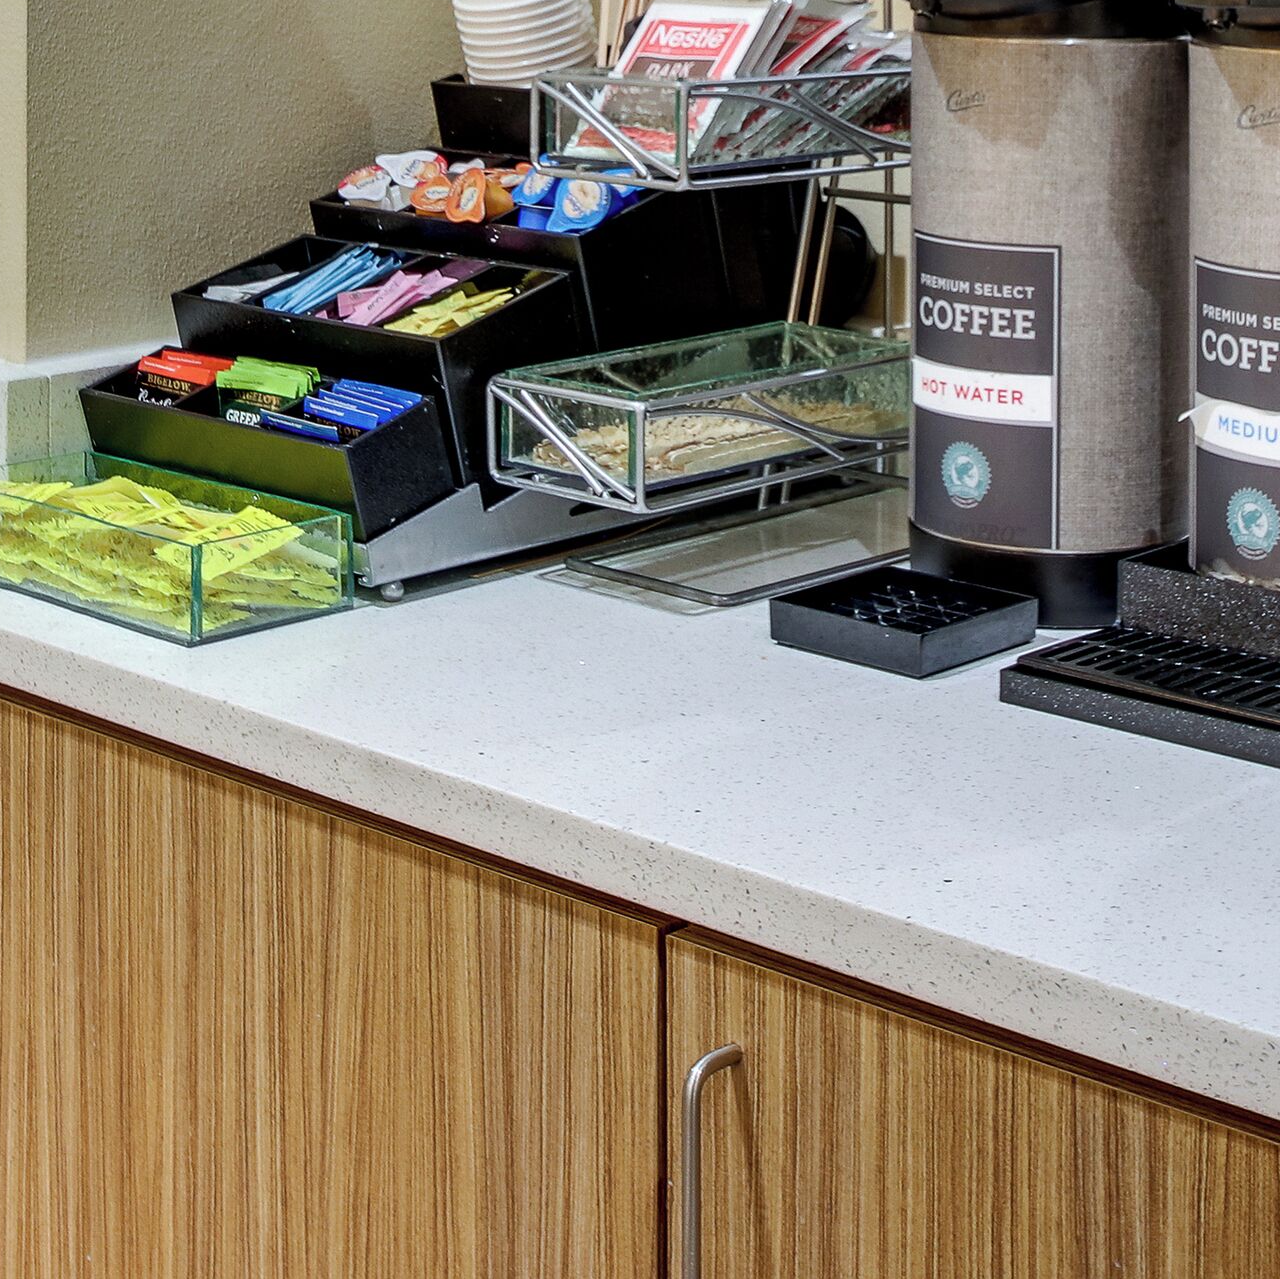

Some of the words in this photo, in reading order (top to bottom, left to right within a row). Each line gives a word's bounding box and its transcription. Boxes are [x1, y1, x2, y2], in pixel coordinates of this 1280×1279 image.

[920, 272, 970, 294] PREMIUM
[974, 282, 1035, 299] SELECT
[919, 295, 1036, 340] COFFEE
[1202, 303, 1257, 328] PREMIUM
[147, 374, 192, 393] BIGELOW
[921, 377, 947, 396] HOT
[954, 384, 1024, 405] WATER
[225, 408, 261, 427] GREEN
